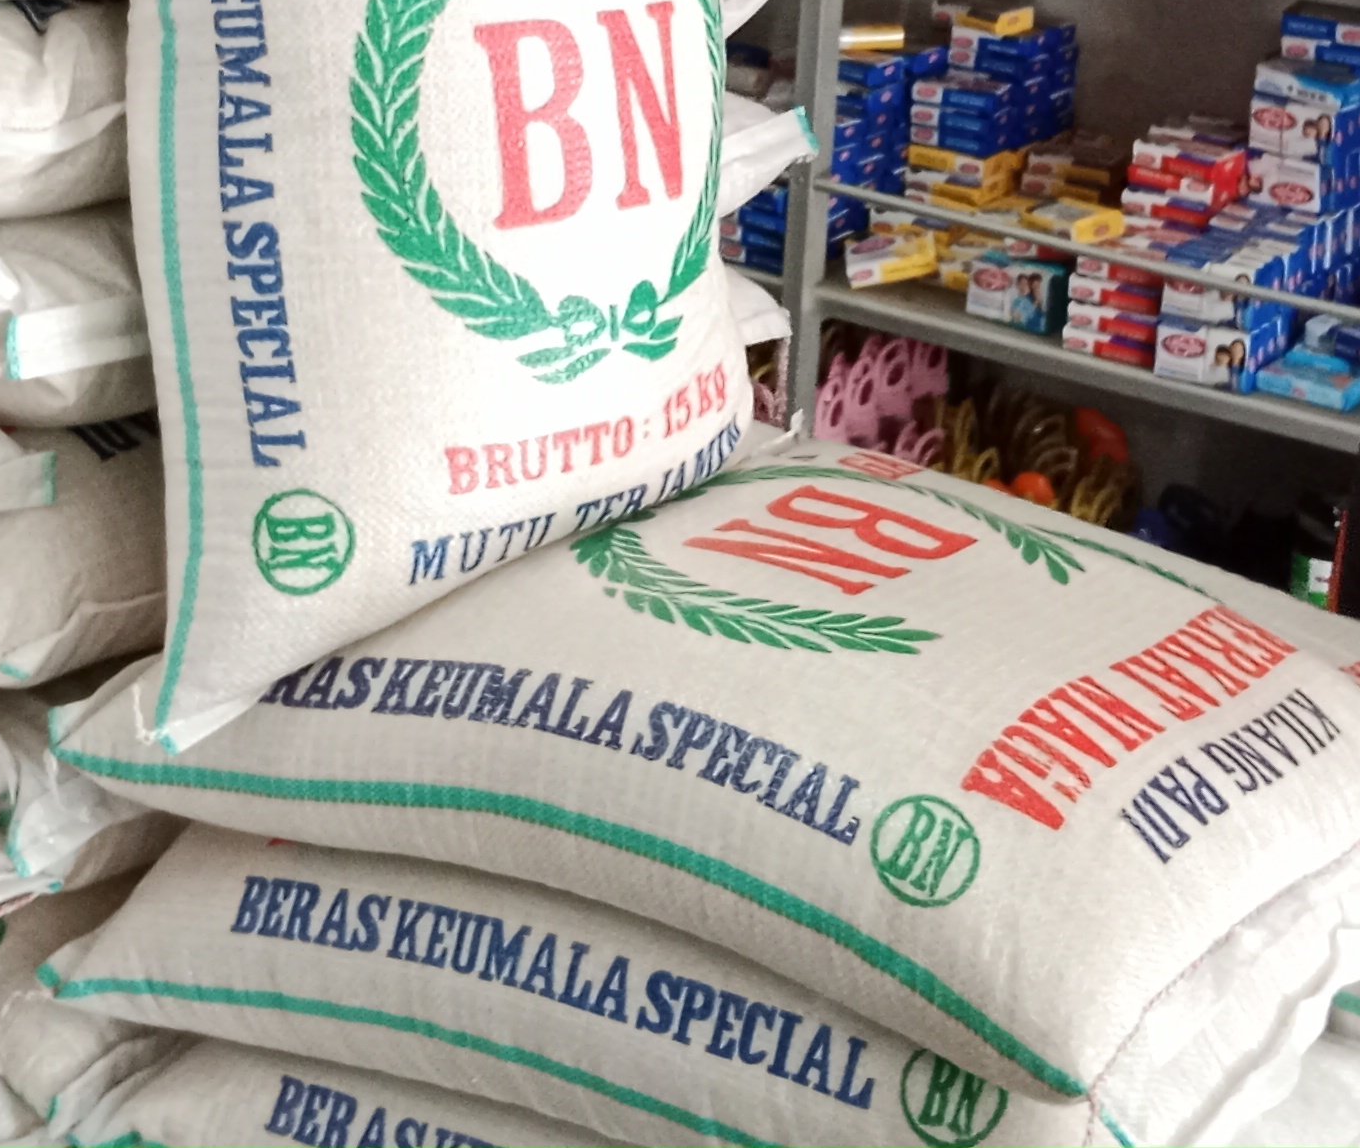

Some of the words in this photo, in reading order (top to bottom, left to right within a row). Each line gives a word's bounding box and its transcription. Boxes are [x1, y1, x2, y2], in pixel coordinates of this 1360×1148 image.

[472, 0, 685, 230] BN
[222, 220, 307, 469] SPECIAL
[661, 392, 692, 440] 15
[692, 362, 729, 418] kg
[266, 512, 340, 583] BN
[408, 510, 558, 586] MUTU
[574, 413, 743, 532] TERJAMIN
[684, 484, 979, 596] BN
[257, 655, 389, 712] RAS
[373, 655, 634, 751] KEUMALA
[632, 699, 862, 847] SPECIAL
[960, 674, 1167, 832] NIAGA
[1197, 687, 1343, 797] KILANG
[896, 800, 970, 903] BN
[1118, 755, 1231, 866] PADI
[231, 874, 390, 955] BERAS
[388, 900, 631, 1024] KEUMALA
[634, 966, 878, 1111] SPECIAL
[263, 1073, 434, 1148] BERAS
[917, 1058, 998, 1140] BN
